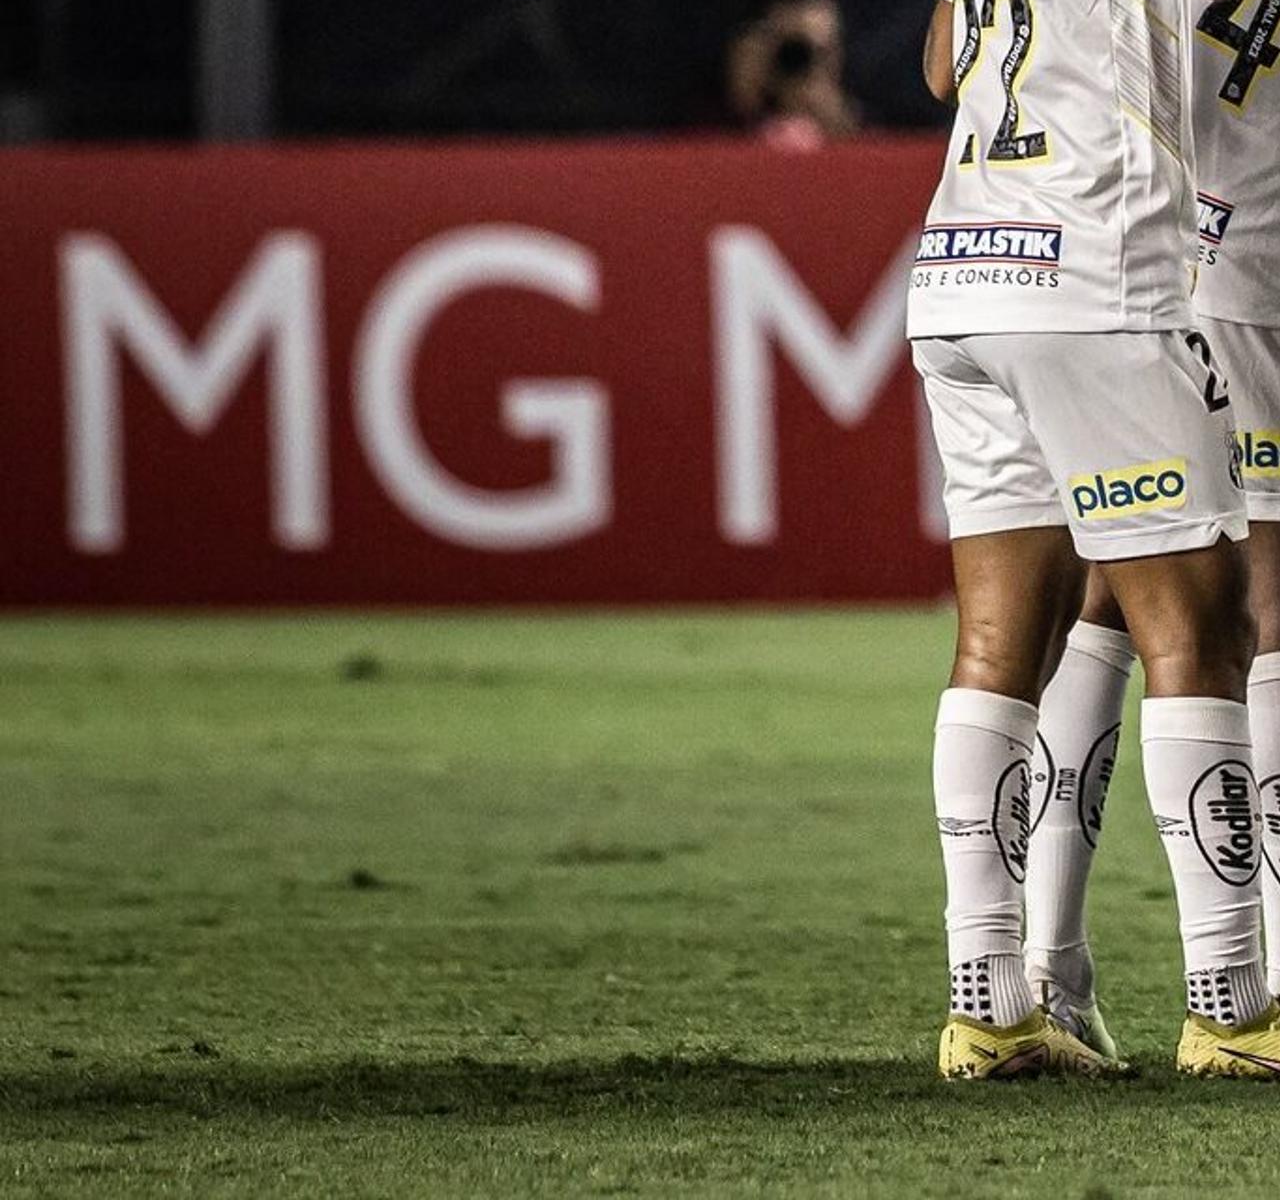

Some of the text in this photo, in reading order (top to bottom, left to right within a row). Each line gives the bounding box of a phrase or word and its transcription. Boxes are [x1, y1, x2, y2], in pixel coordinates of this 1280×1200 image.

[952, 229, 1057, 259] PLASTIK
[57, 224, 955, 555] MGM
[1071, 468, 1185, 518] placo
[1207, 768, 1254, 871] Kodilar
